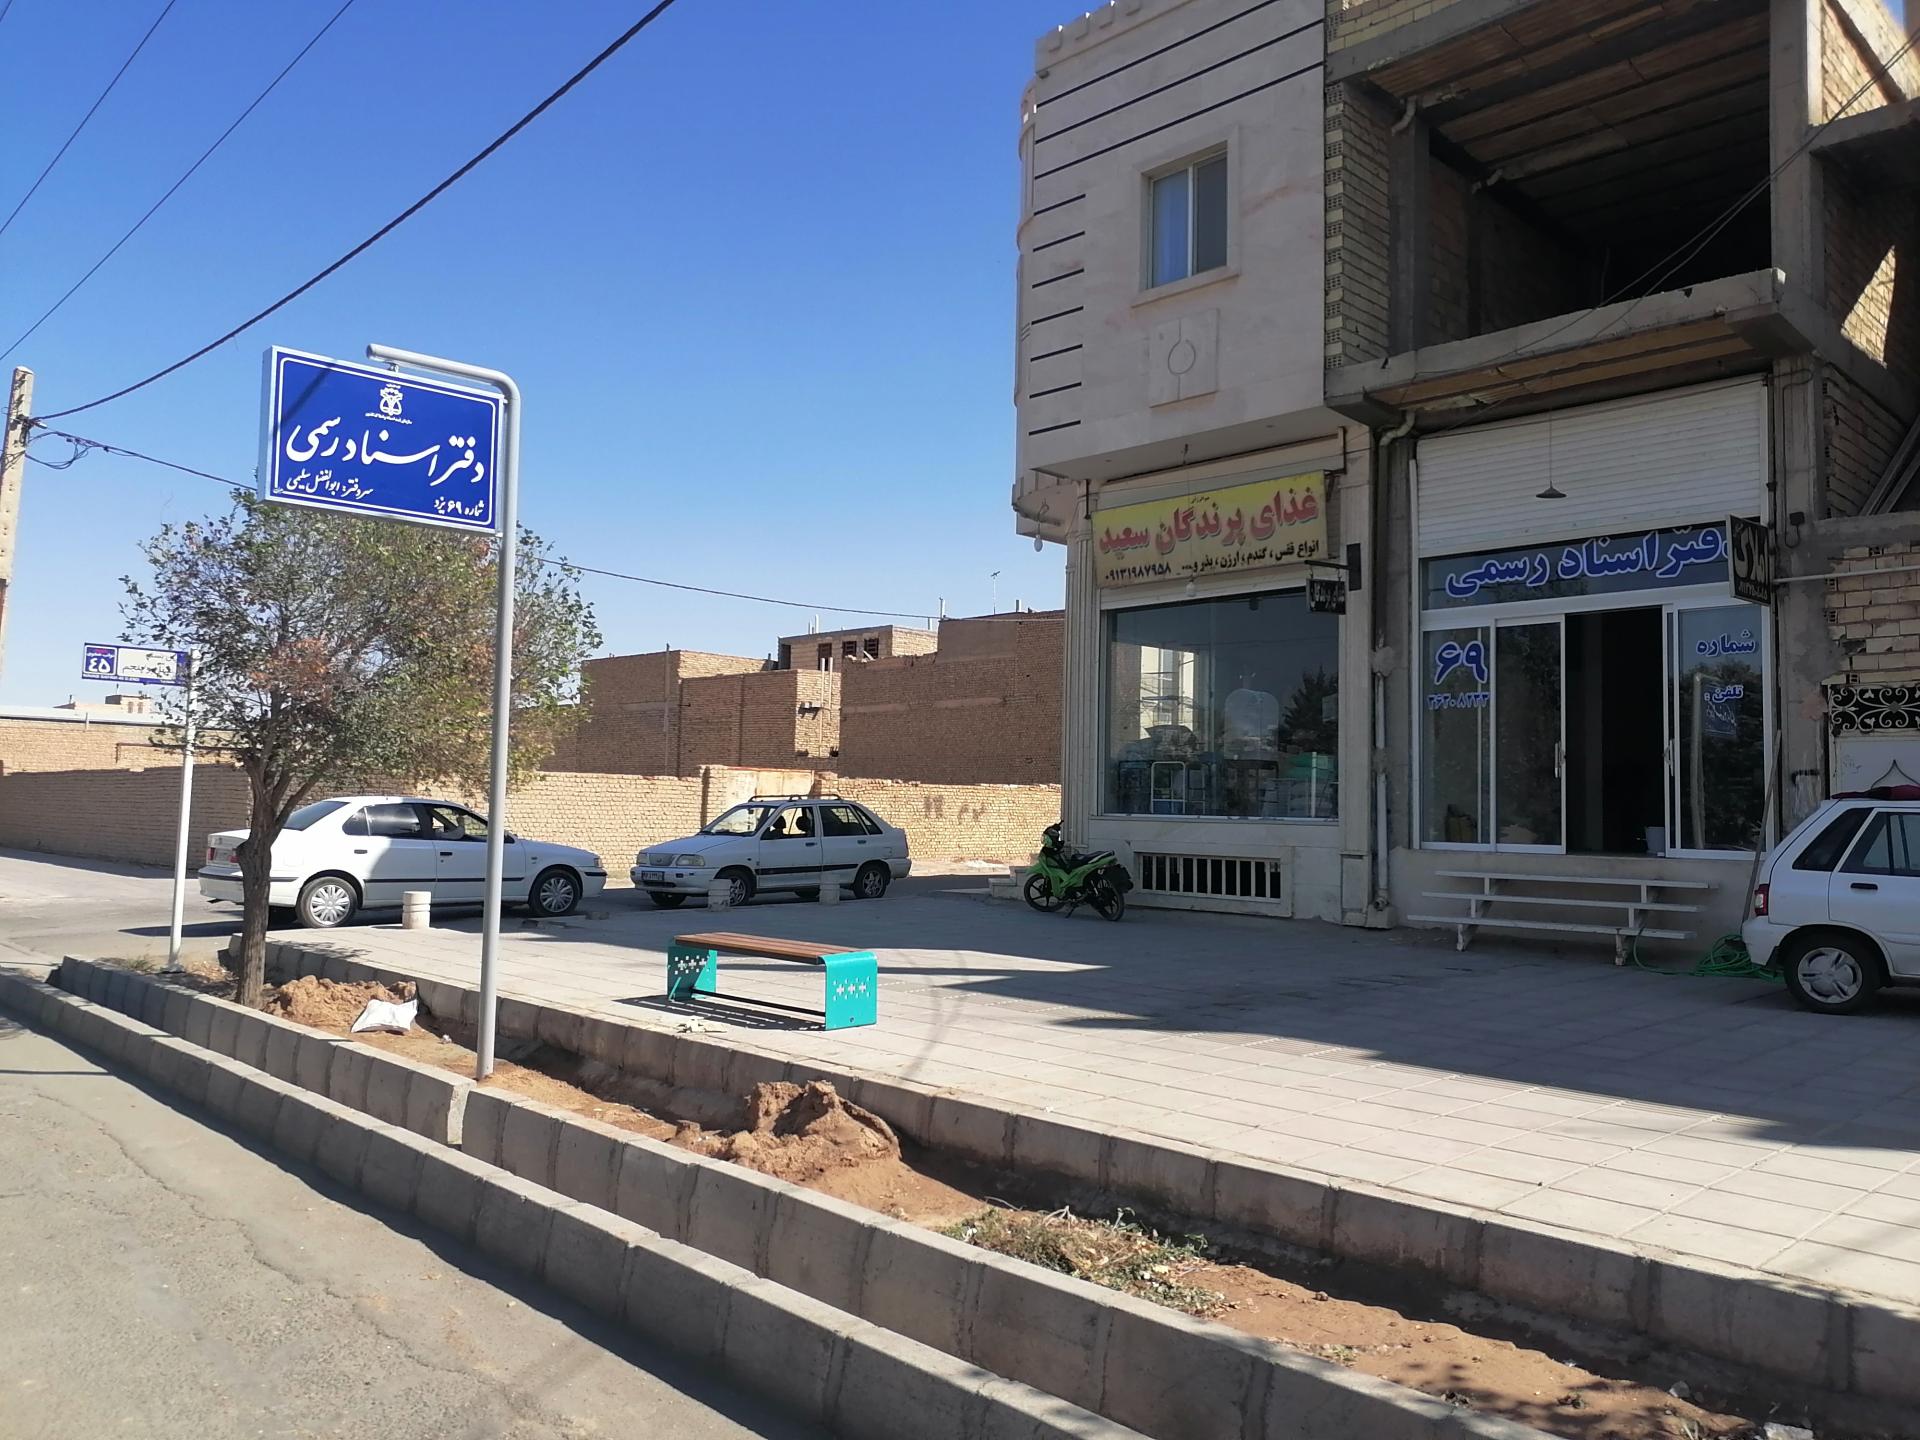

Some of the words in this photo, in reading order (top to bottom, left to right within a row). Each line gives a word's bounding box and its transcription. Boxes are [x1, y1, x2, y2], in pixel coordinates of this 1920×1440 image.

[285, 416, 341, 462] رسمی
[342, 425, 441, 477] اسناد
[429, 435, 485, 487] دفتر
[305, 469, 340, 496] ابوالفضل
[433, 496, 446, 515] یزد
[447, 500, 462, 515] ۶۹
[464, 499, 485, 517] شماره
[1250, 485, 1319, 540] غذای
[1099, 526, 1151, 559] سعید
[1155, 502, 1246, 556] پرندگان
[1297, 540, 1319, 558] انواع
[1558, 530, 1660, 579] اسناد
[1105, 562, 1172, 581] ۰۹۱۳۱۹۸۷۹۵۸
[1445, 553, 1551, 598] رسمی
[1434, 640, 1489, 685] ۶۹
[1696, 629, 1757, 657] شماره
